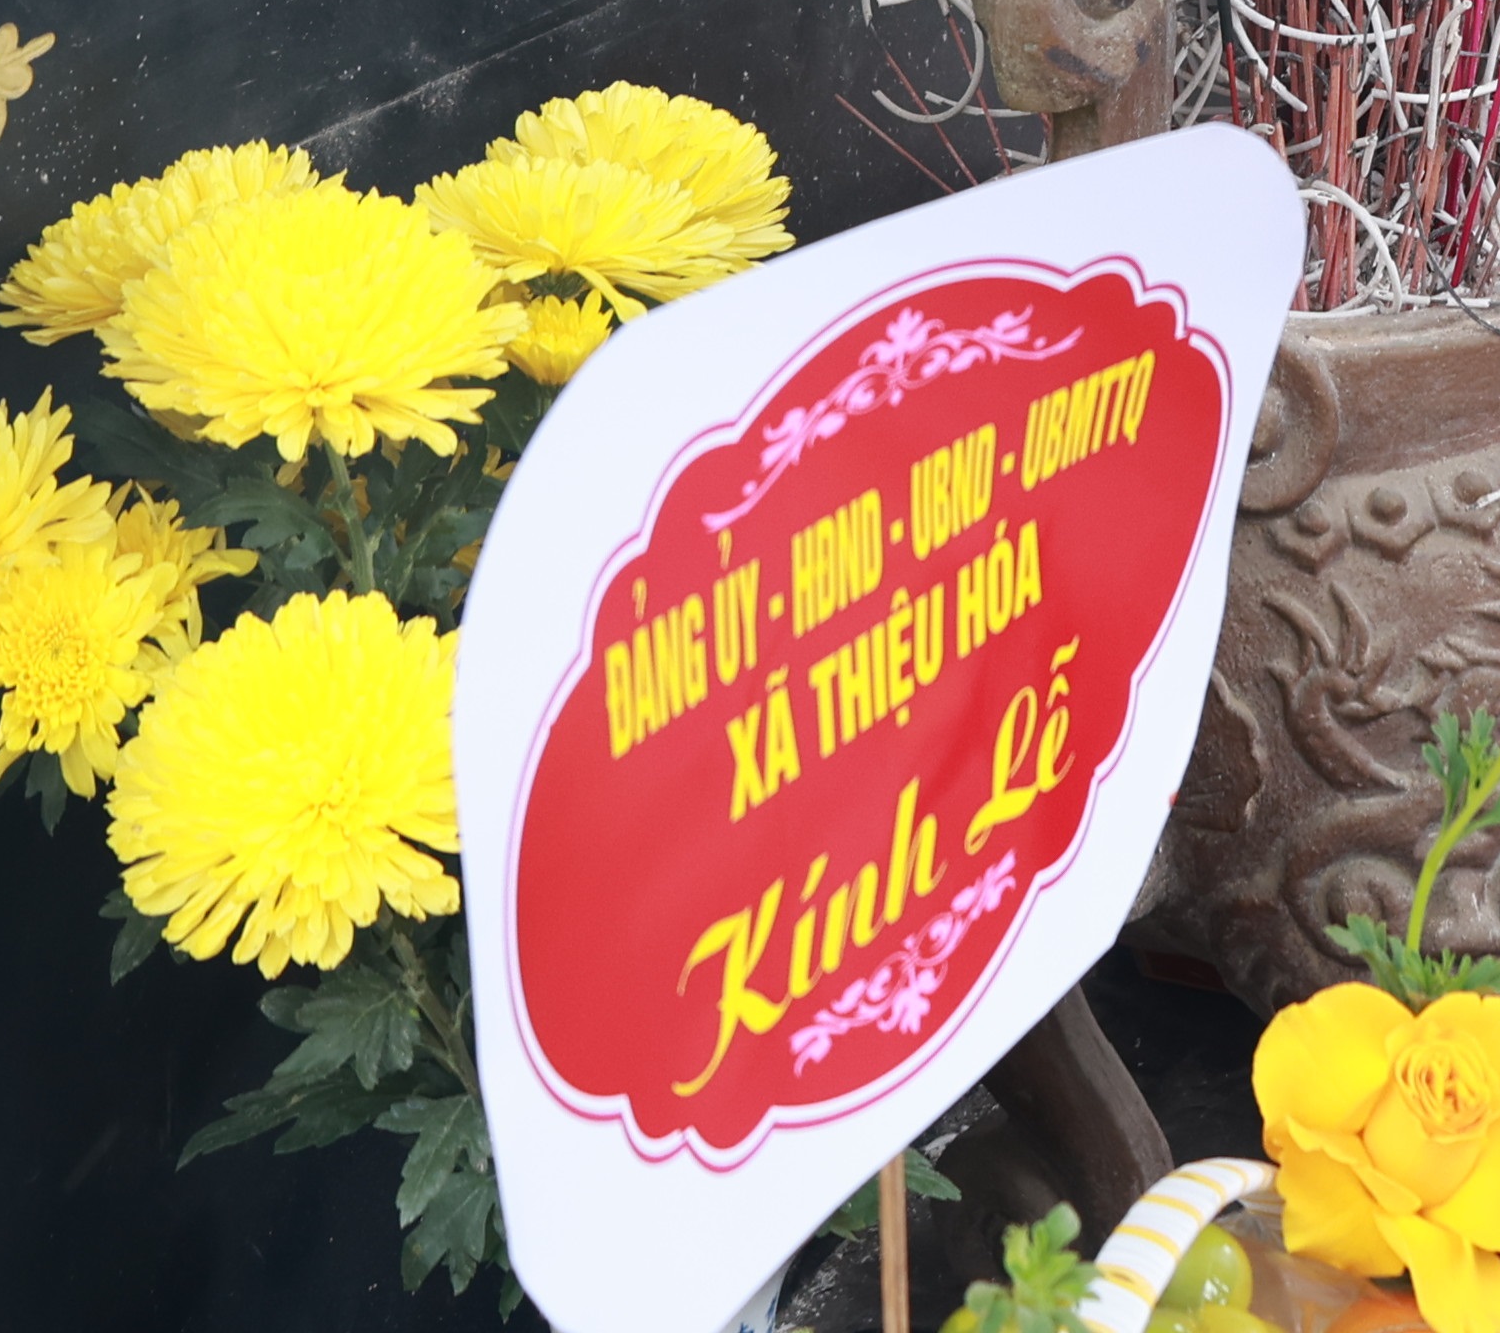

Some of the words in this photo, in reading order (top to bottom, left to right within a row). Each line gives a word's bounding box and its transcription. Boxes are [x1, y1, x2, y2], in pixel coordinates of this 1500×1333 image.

[604, 577, 708, 761] ĐẢNG
[712, 528, 760, 686] ỦY
[791, 487, 883, 639] HĐND
[910, 422, 997, 561] UBND
[1021, 349, 1156, 491] UBMTTQ
[725, 664, 801, 824] XÃ
[809, 587, 944, 759] THIỆU
[957, 518, 1042, 660] HÓA
[672, 776, 946, 1098] Kính
[964, 634, 1080, 858] Lễ
